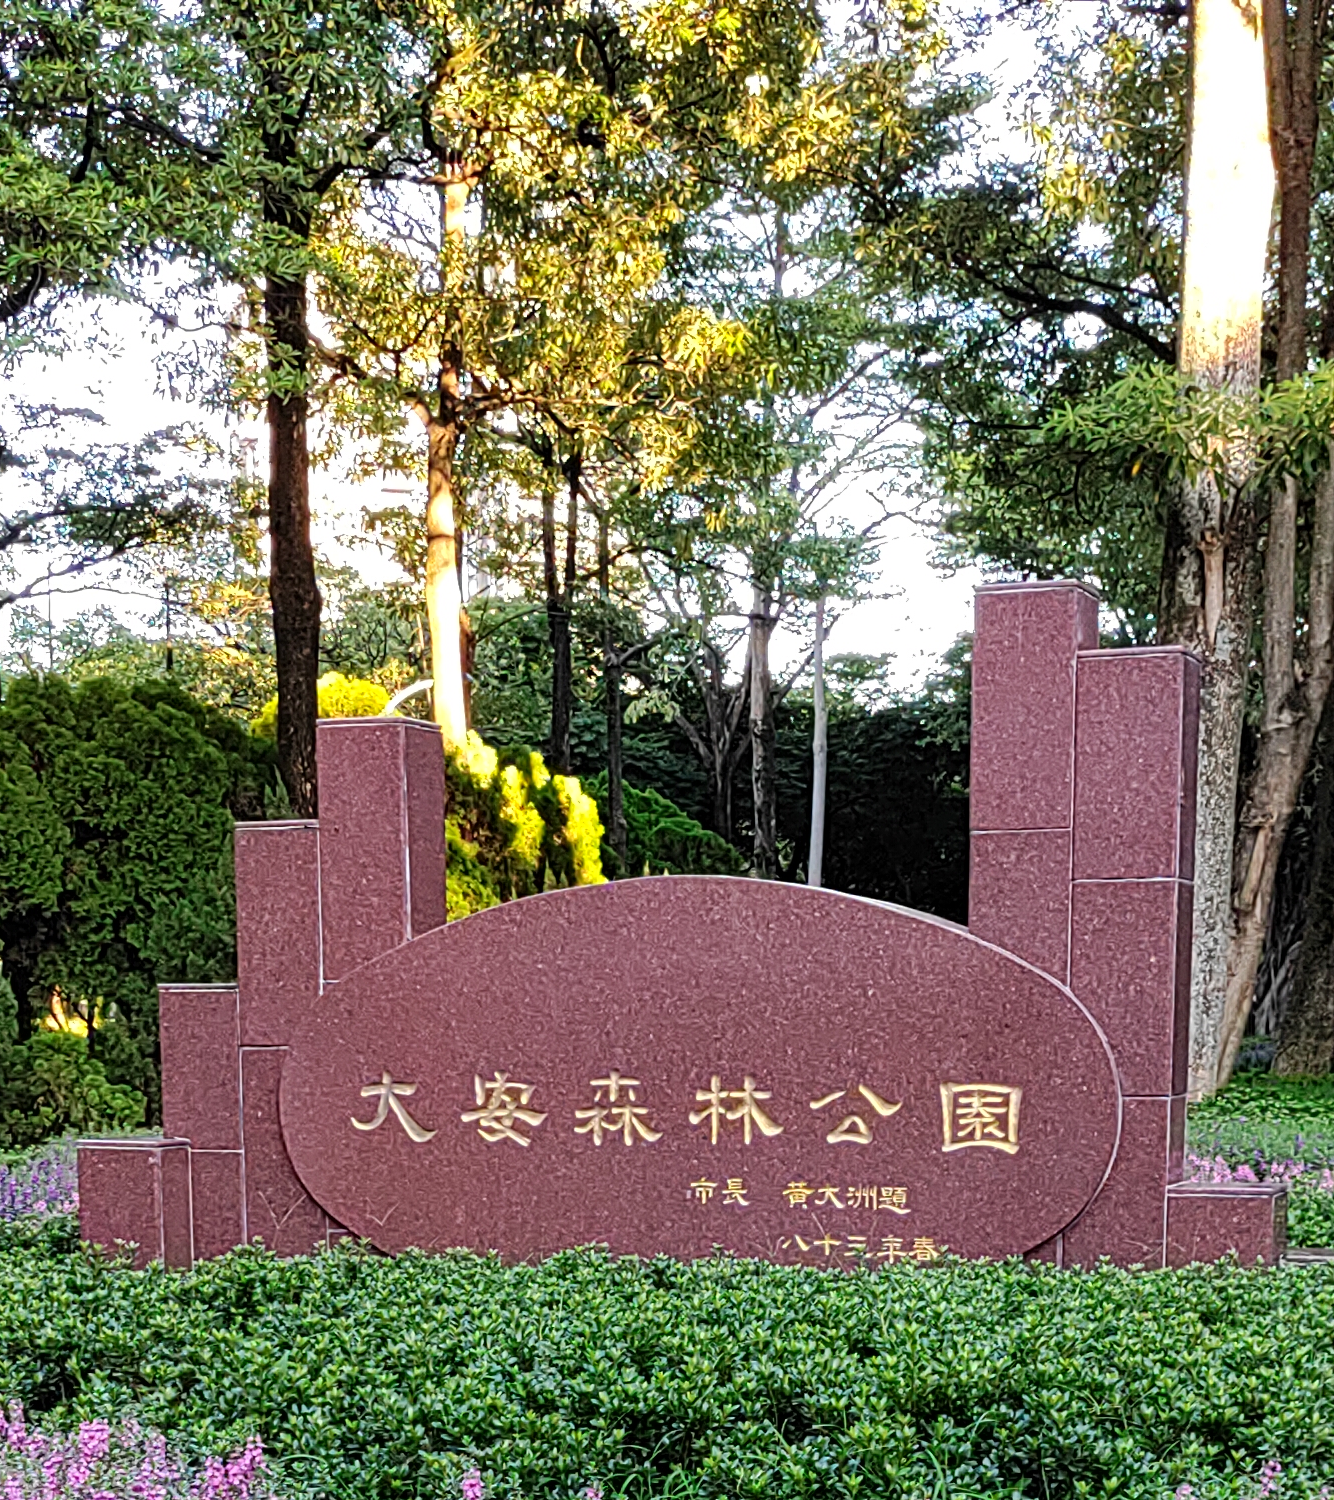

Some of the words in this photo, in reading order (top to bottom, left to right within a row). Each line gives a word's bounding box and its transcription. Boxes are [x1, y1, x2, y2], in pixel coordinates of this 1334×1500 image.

[351, 1070, 1022, 1154] 大安森林公園
[690, 1177, 749, 1206] 市長
[782, 1234, 941, 1264] 八十三年春
